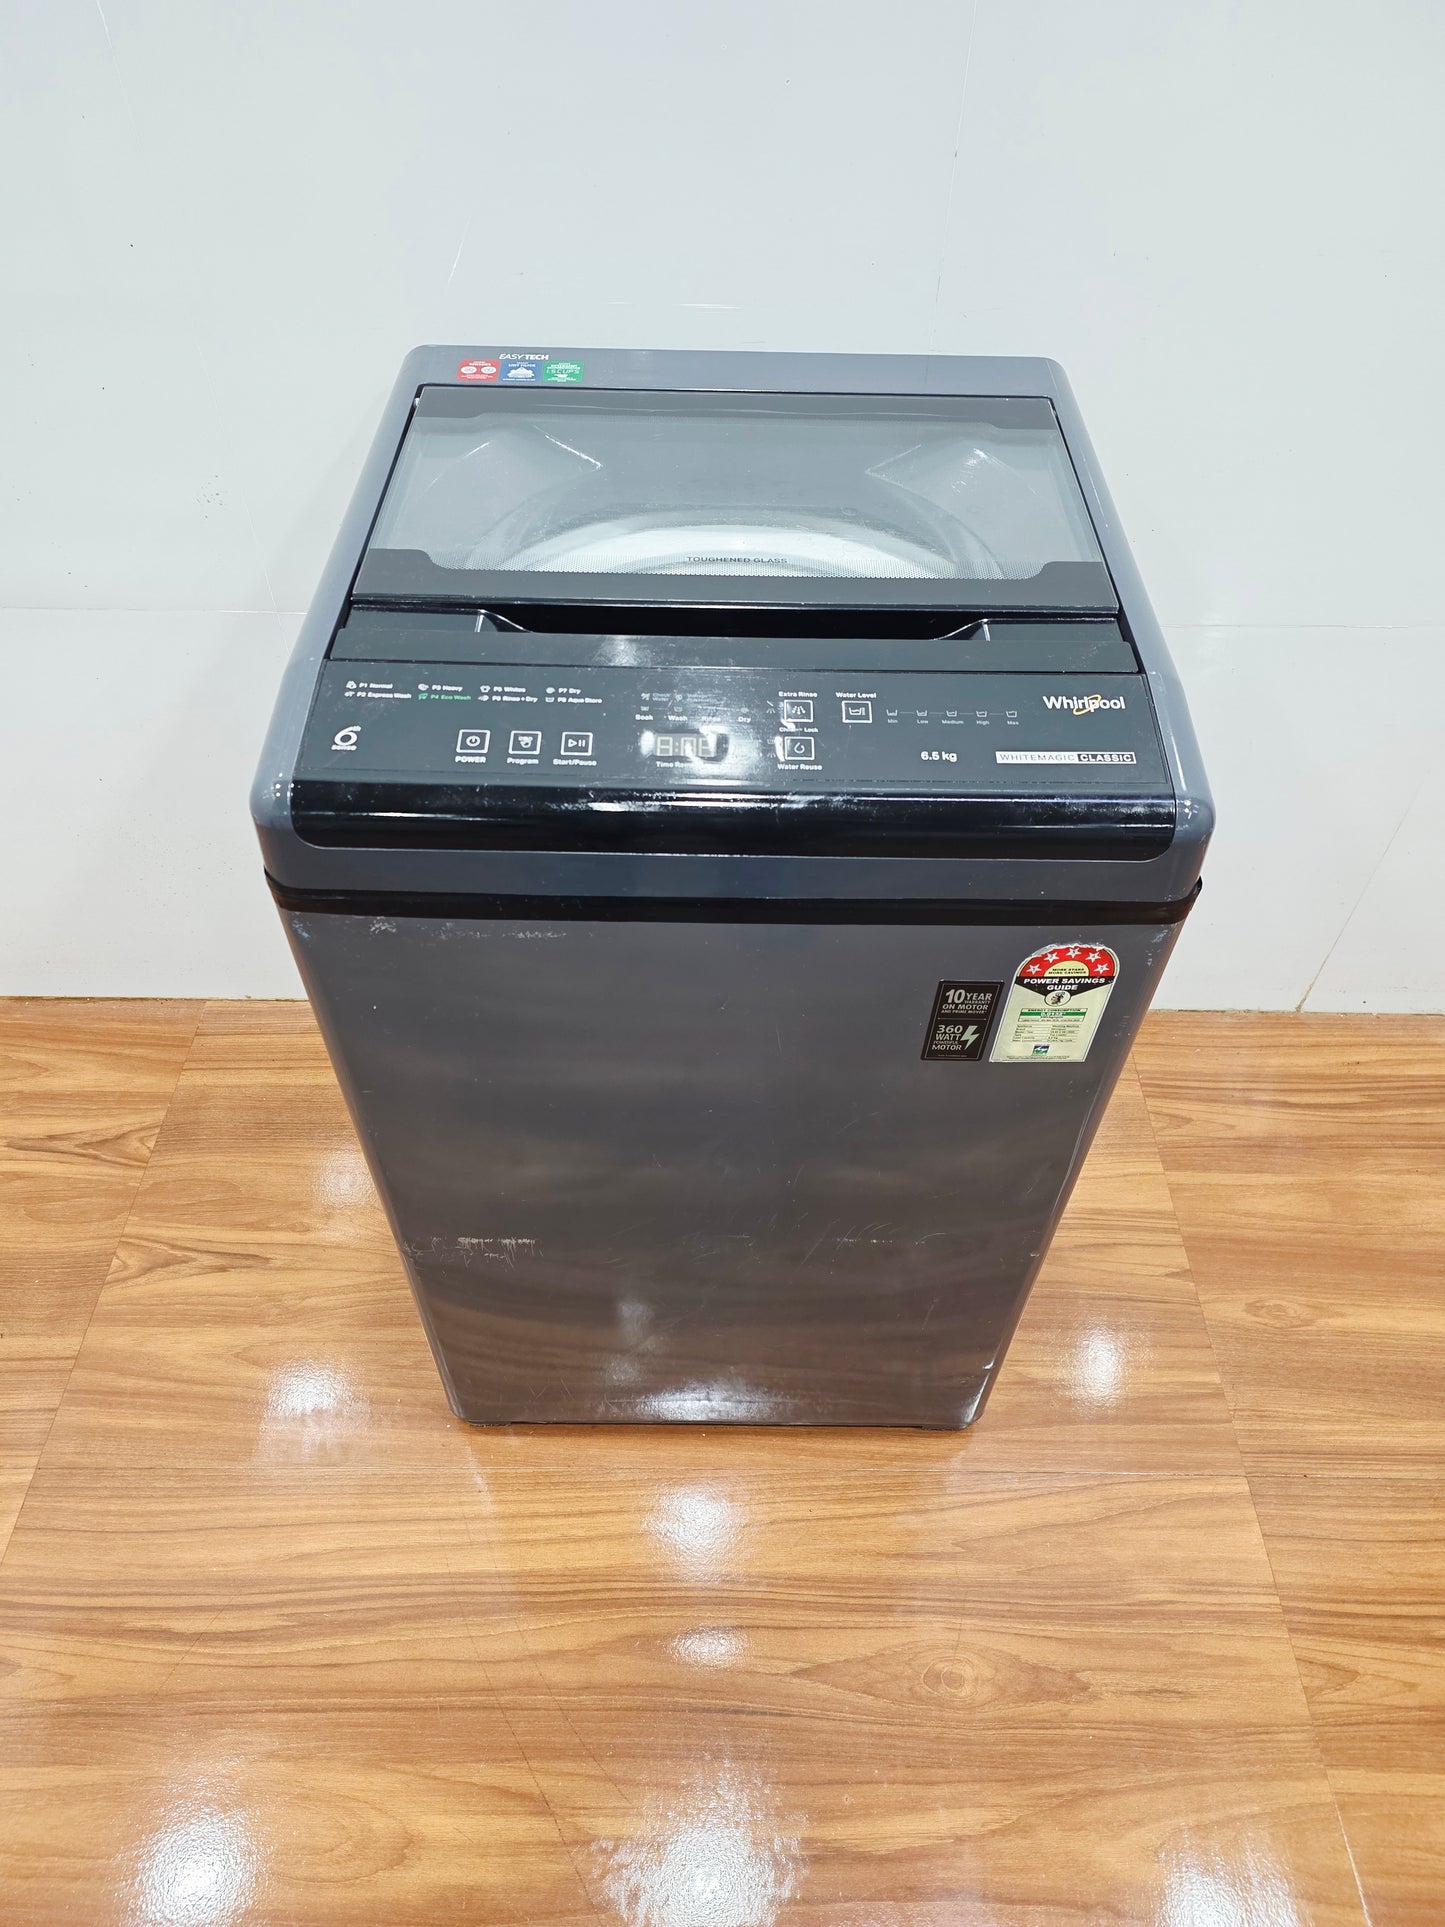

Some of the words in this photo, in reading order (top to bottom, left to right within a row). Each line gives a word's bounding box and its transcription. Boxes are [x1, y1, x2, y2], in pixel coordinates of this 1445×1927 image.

[1042, 695, 1126, 713] Whirlpool
[507, 757, 539, 765] Program
[921, 751, 940, 761] 6.5
[942, 751, 958, 763] kg
[1000, 754, 1075, 762] WHITEMAGIC
[1080, 754, 1133, 762] CLASSIC
[945, 989, 966, 1004] 10
[966, 992, 993, 1001] YEAR
[937, 1024, 963, 1034] 360
[935, 1033, 962, 1041] WATT
